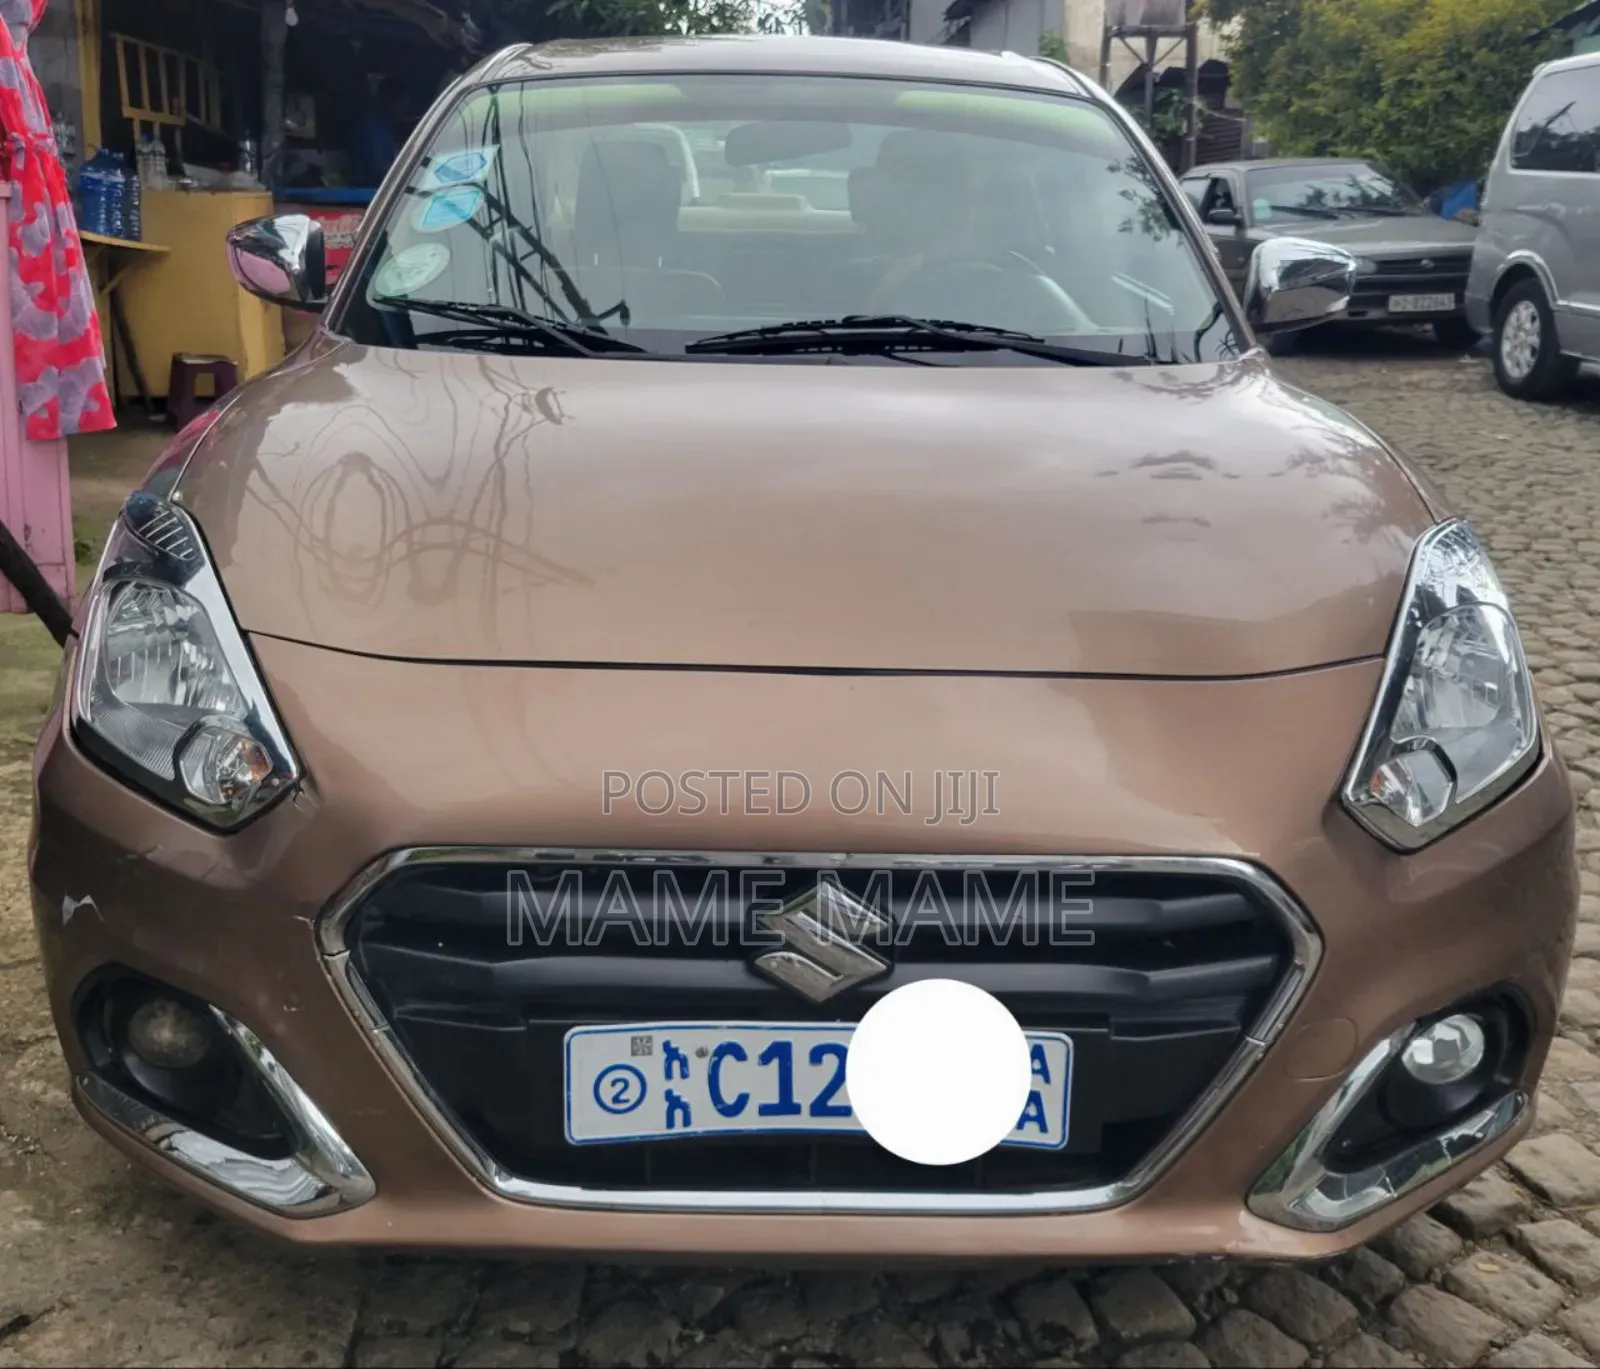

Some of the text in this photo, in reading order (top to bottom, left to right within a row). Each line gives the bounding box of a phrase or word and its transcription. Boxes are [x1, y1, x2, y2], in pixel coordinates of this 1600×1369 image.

[610, 1077, 630, 1105] 2
[707, 1040, 852, 1118] C12
[1015, 1090, 1048, 1133] A
